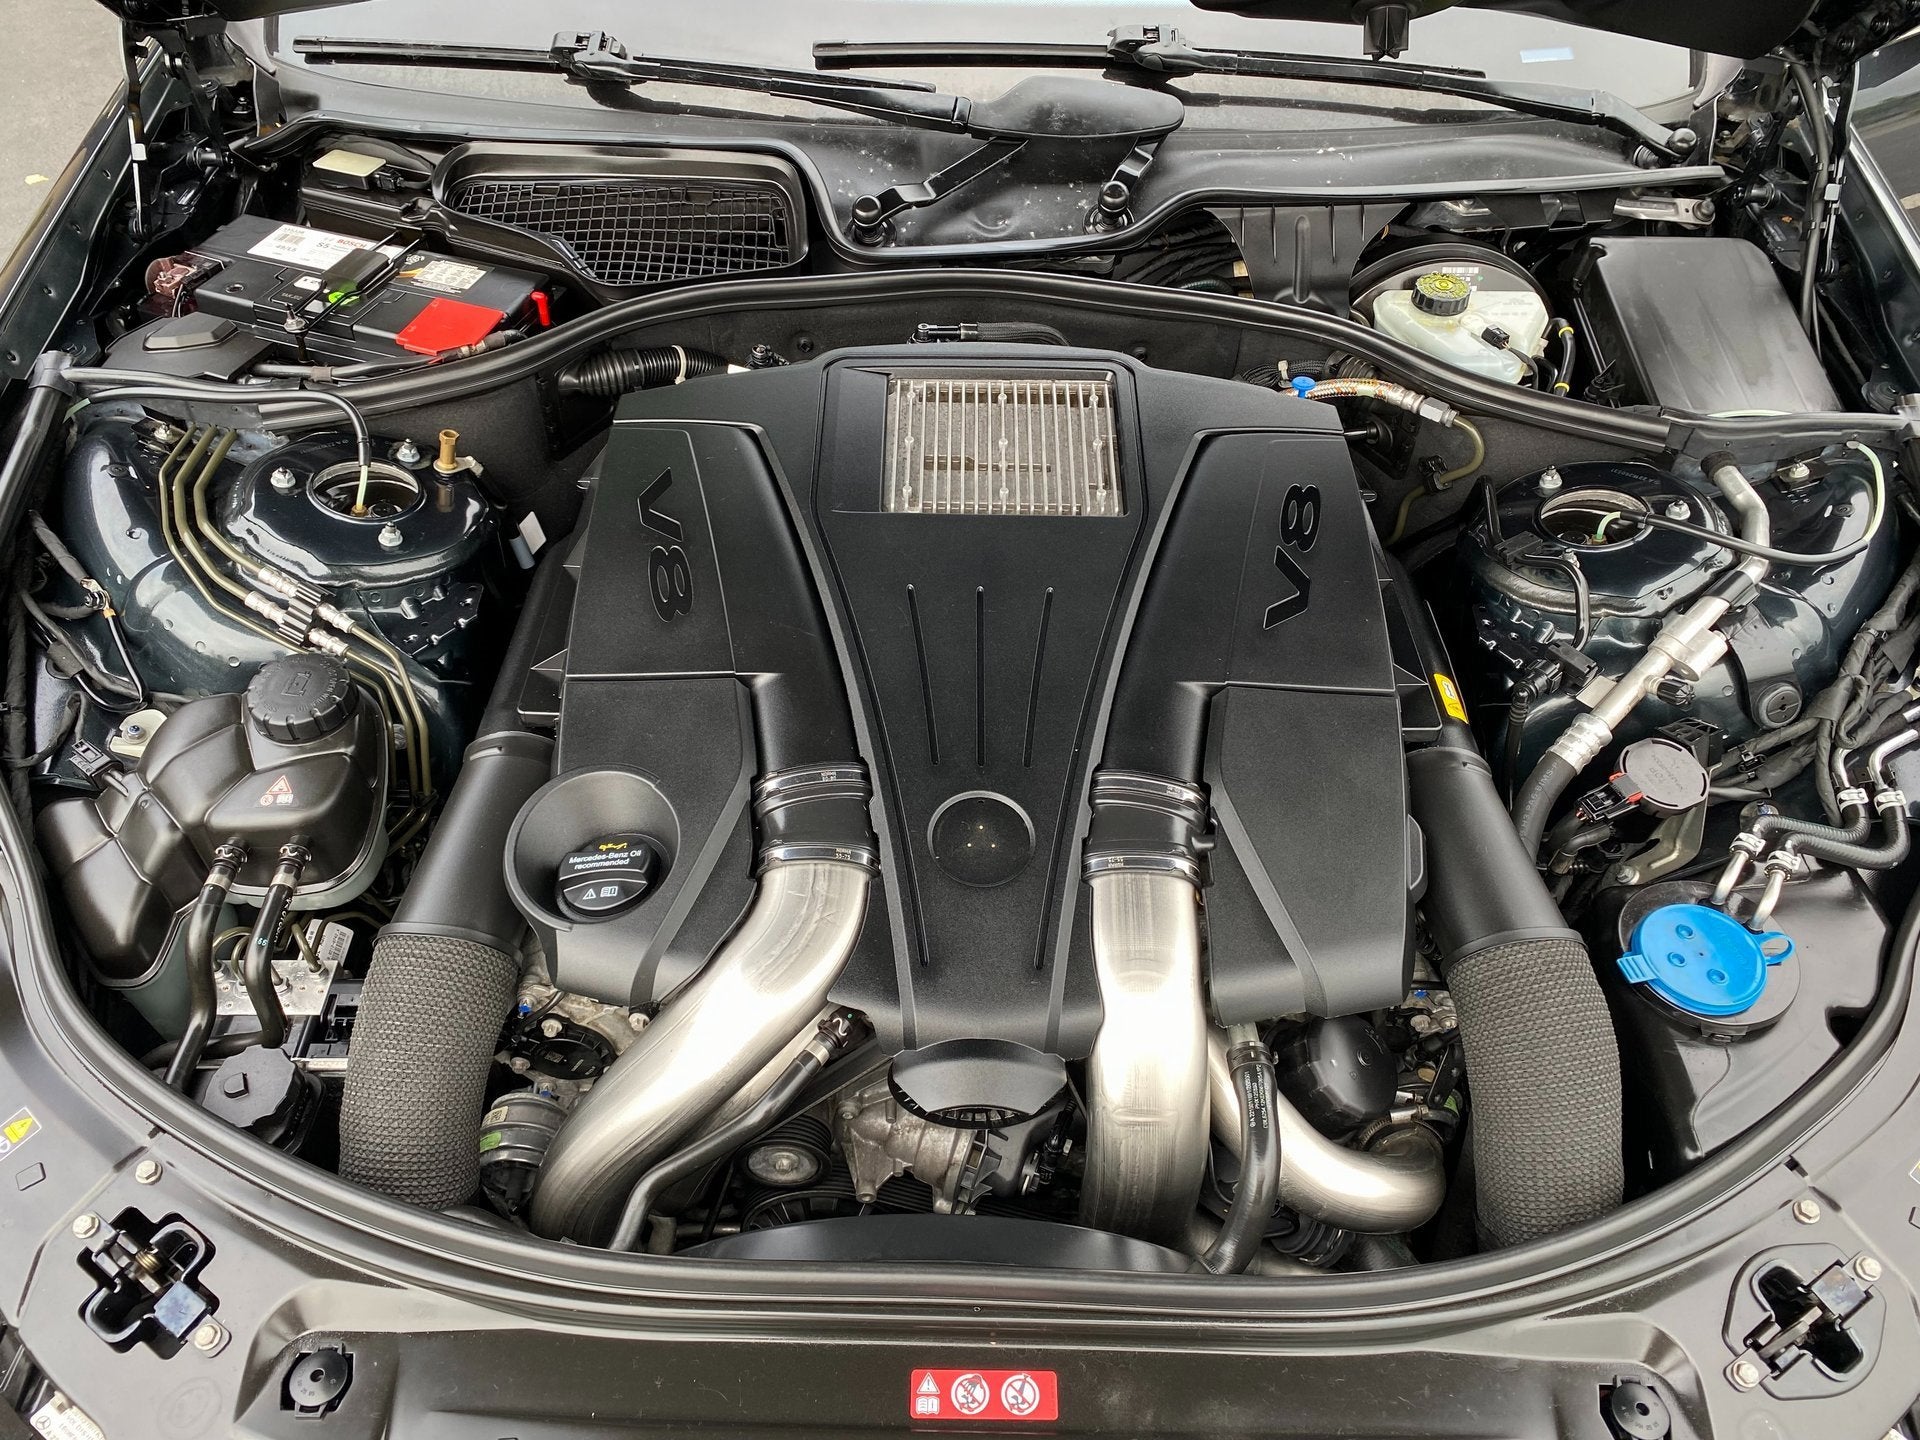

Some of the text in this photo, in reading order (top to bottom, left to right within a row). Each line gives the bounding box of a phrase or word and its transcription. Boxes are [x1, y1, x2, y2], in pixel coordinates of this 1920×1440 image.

[337, 238, 368, 249] BOSCH
[638, 466, 694, 623] V8
[1263, 483, 1321, 630] V8
[568, 849, 642, 864] Mercedes-Benz Oil
[574, 858, 630, 870] recommended
